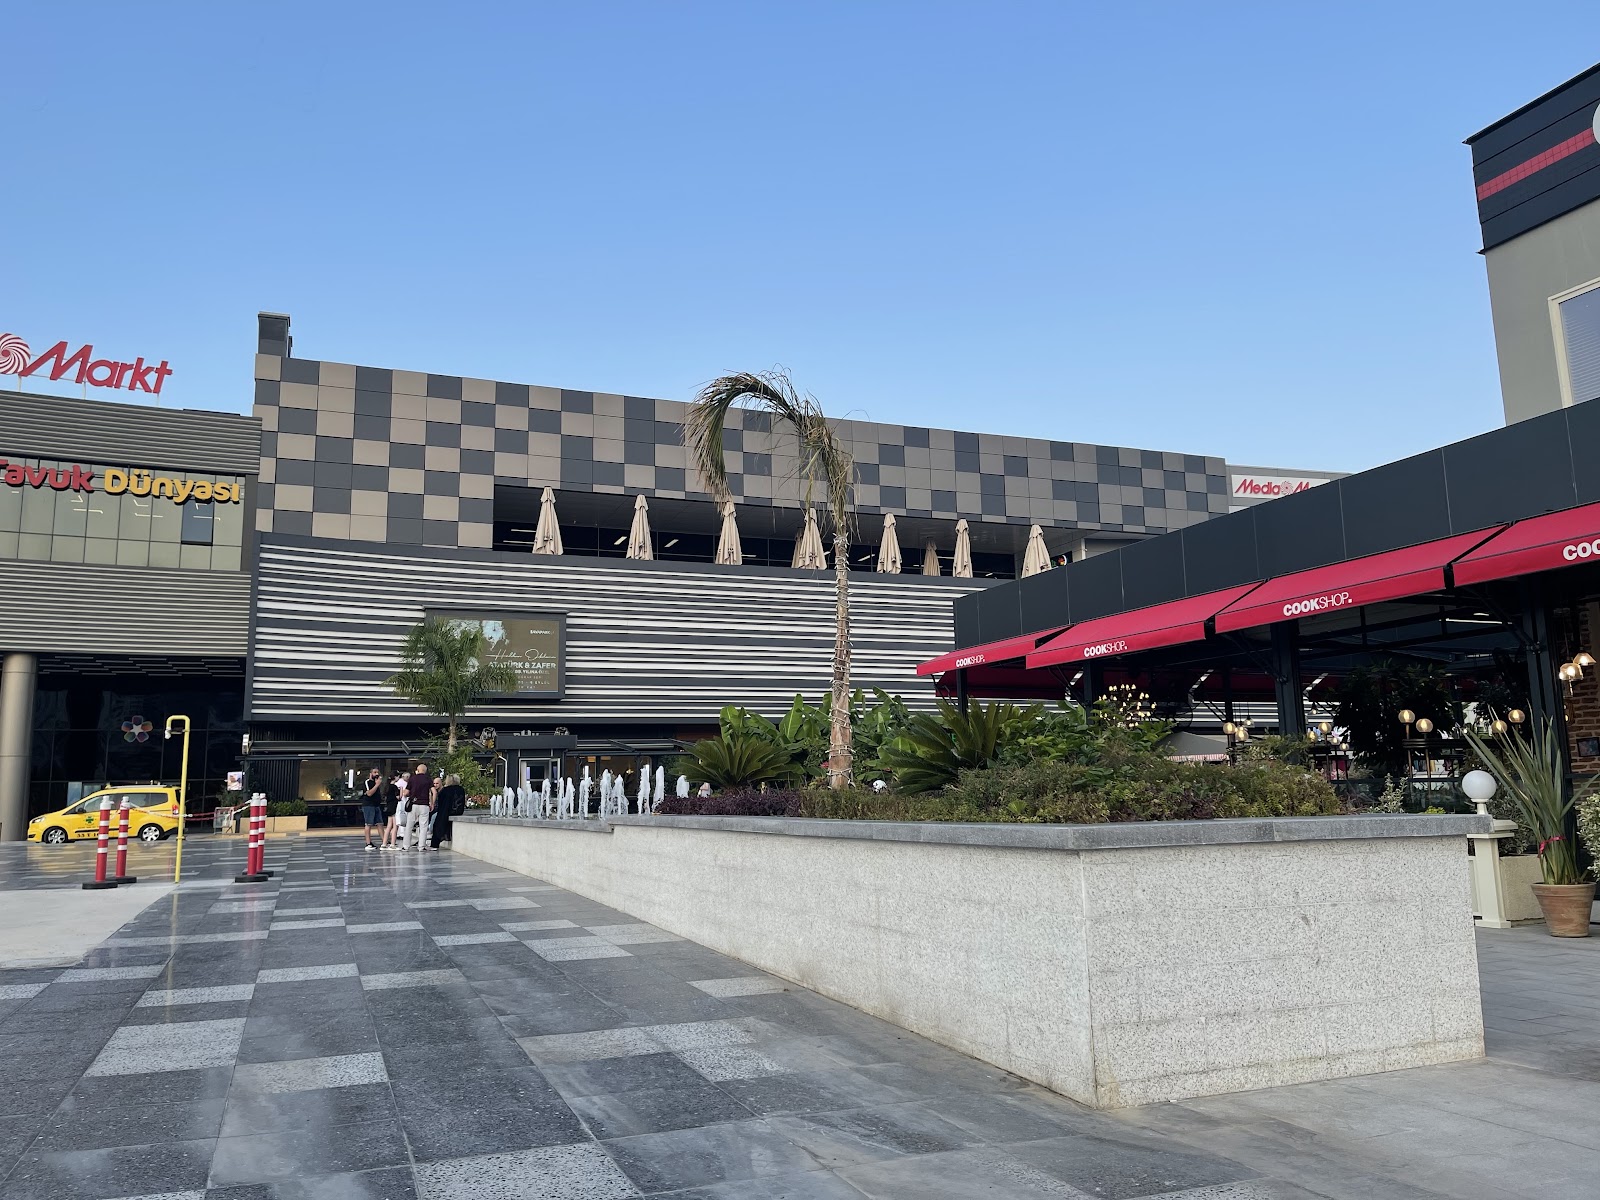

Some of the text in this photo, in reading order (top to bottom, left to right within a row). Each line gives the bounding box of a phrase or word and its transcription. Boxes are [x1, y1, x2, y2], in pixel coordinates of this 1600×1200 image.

[20, 341, 173, 394] Markt
[104, 469, 240, 503] Dünyası
[1234, 478, 1281, 496] Media
